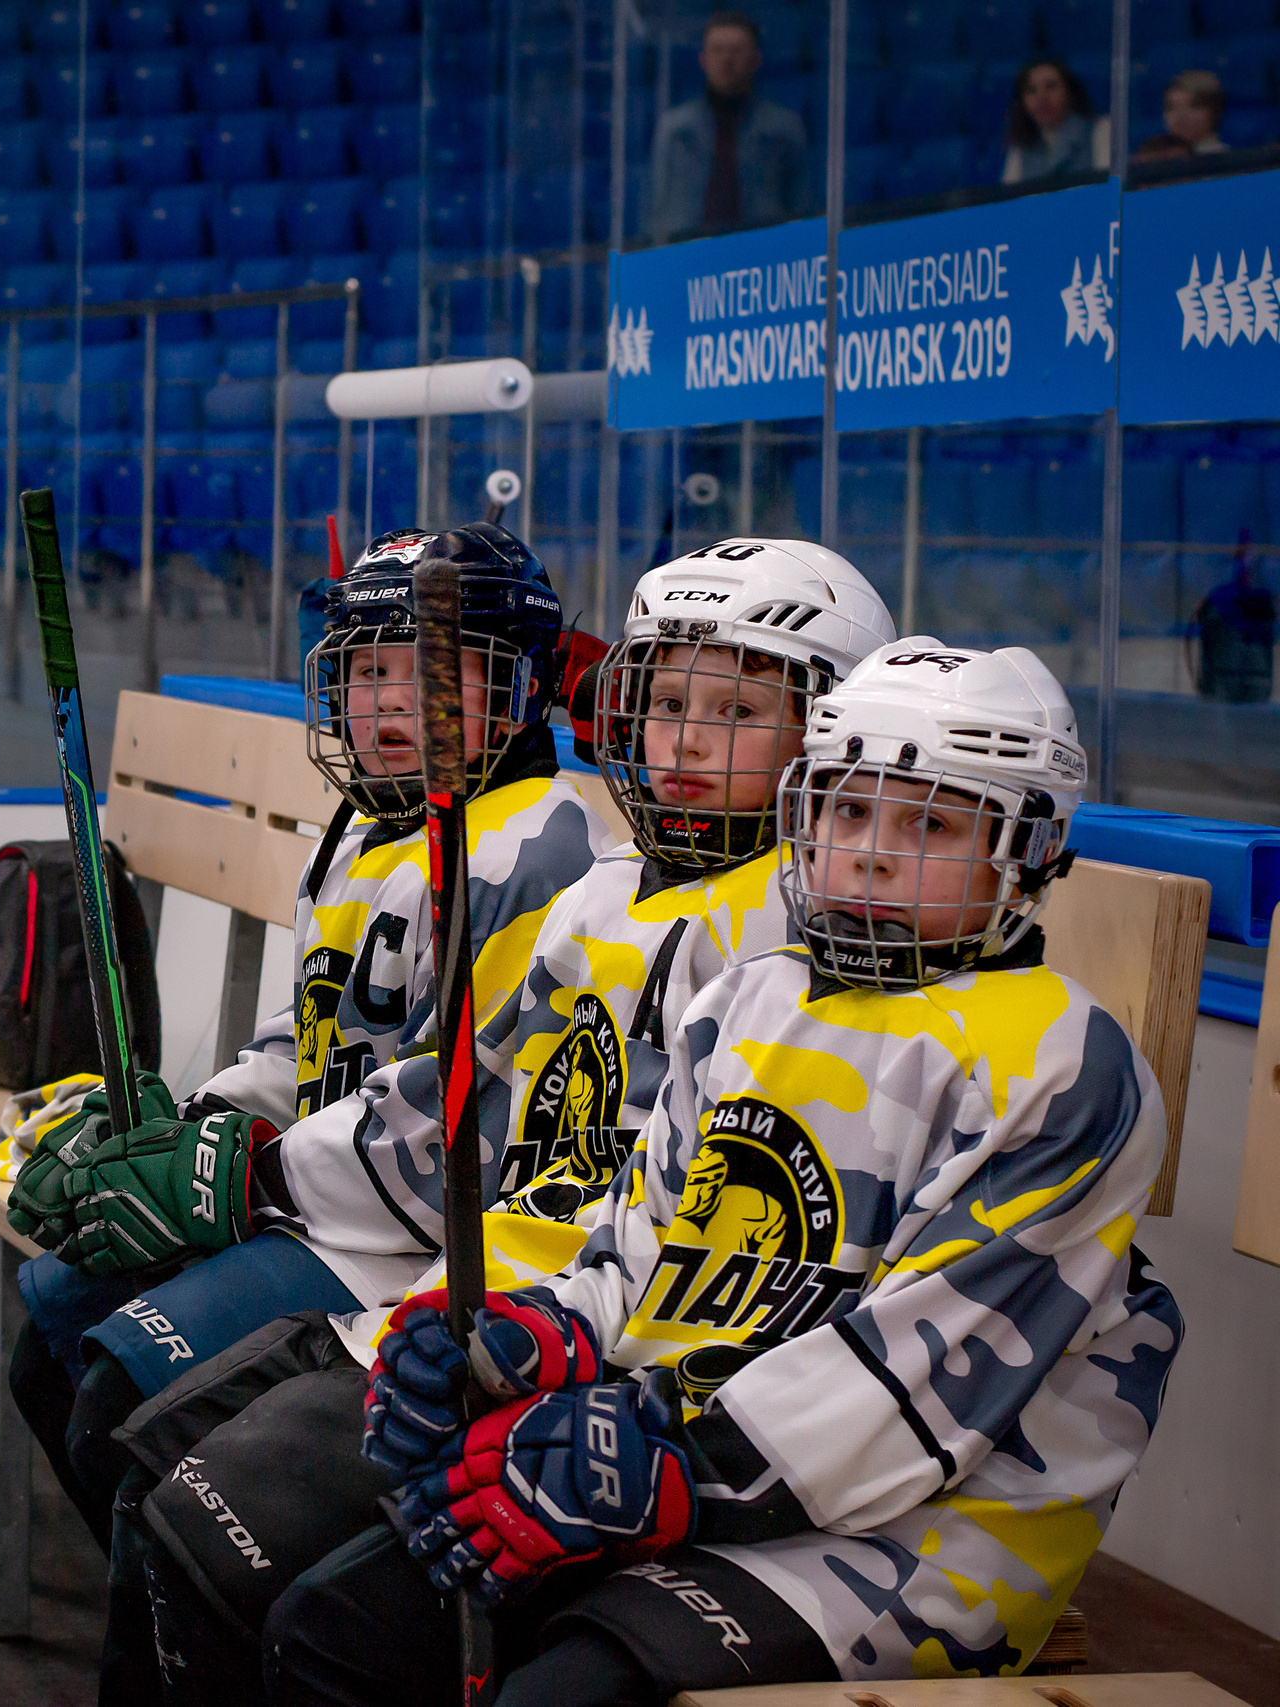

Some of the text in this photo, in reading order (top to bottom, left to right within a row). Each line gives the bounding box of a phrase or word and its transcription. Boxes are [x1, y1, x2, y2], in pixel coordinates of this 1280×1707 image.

[687, 266, 763, 323] WINTER
[852, 243, 1010, 319] UNIVERSIADE
[950, 314, 1012, 381] 2019
[345, 586, 410, 602] BAUER
[525, 594, 560, 613] BAUER
[663, 590, 732, 604] CCM
[1052, 749, 1086, 775] BAUER
[661, 818, 711, 831] CCM
[353, 911, 410, 1025] C
[627, 917, 689, 1052] A
[823, 949, 893, 970] BAUER
[192, 1111, 229, 1225] UER
[789, 1140, 833, 1231] КЛУБ
[586, 1386, 623, 1509] UER
[180, 1470, 273, 1570] EASTON
